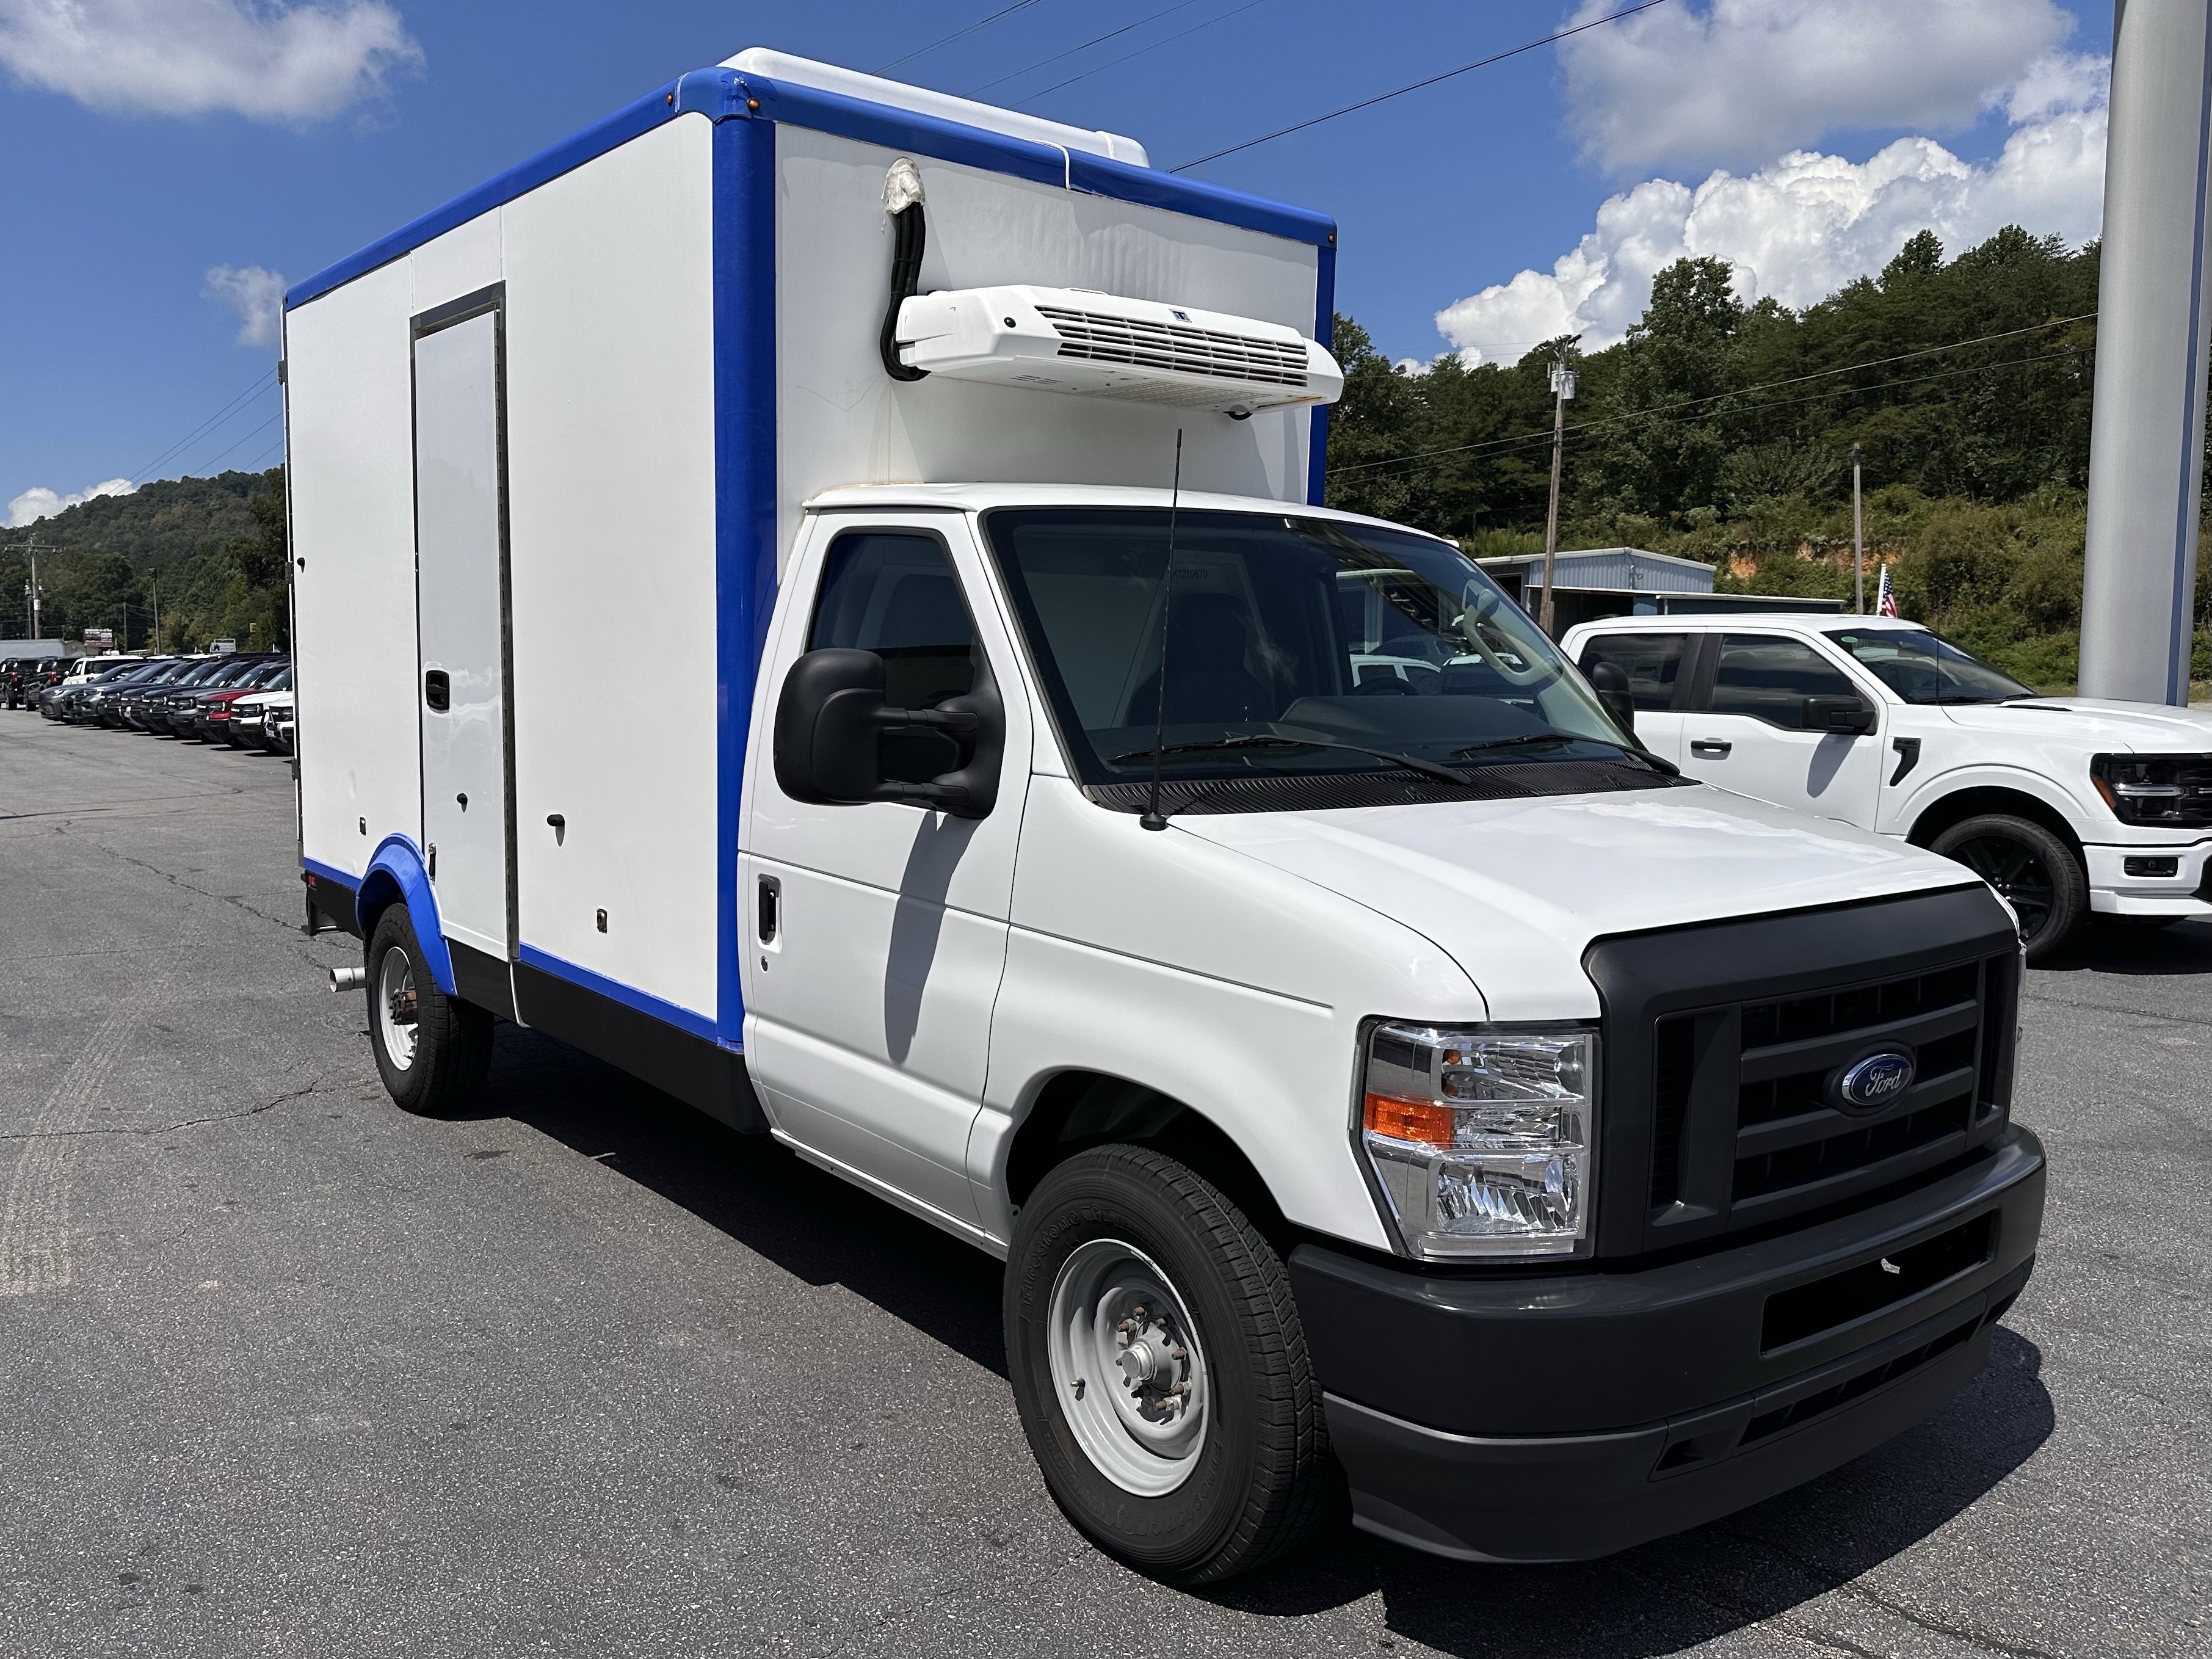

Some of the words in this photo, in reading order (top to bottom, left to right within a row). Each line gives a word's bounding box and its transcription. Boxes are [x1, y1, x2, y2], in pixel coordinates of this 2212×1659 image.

[1865, 1064, 1902, 1097] Ford
[1020, 1210, 1080, 1308] Firestone
[1152, 1440, 1224, 1536] Firestone
